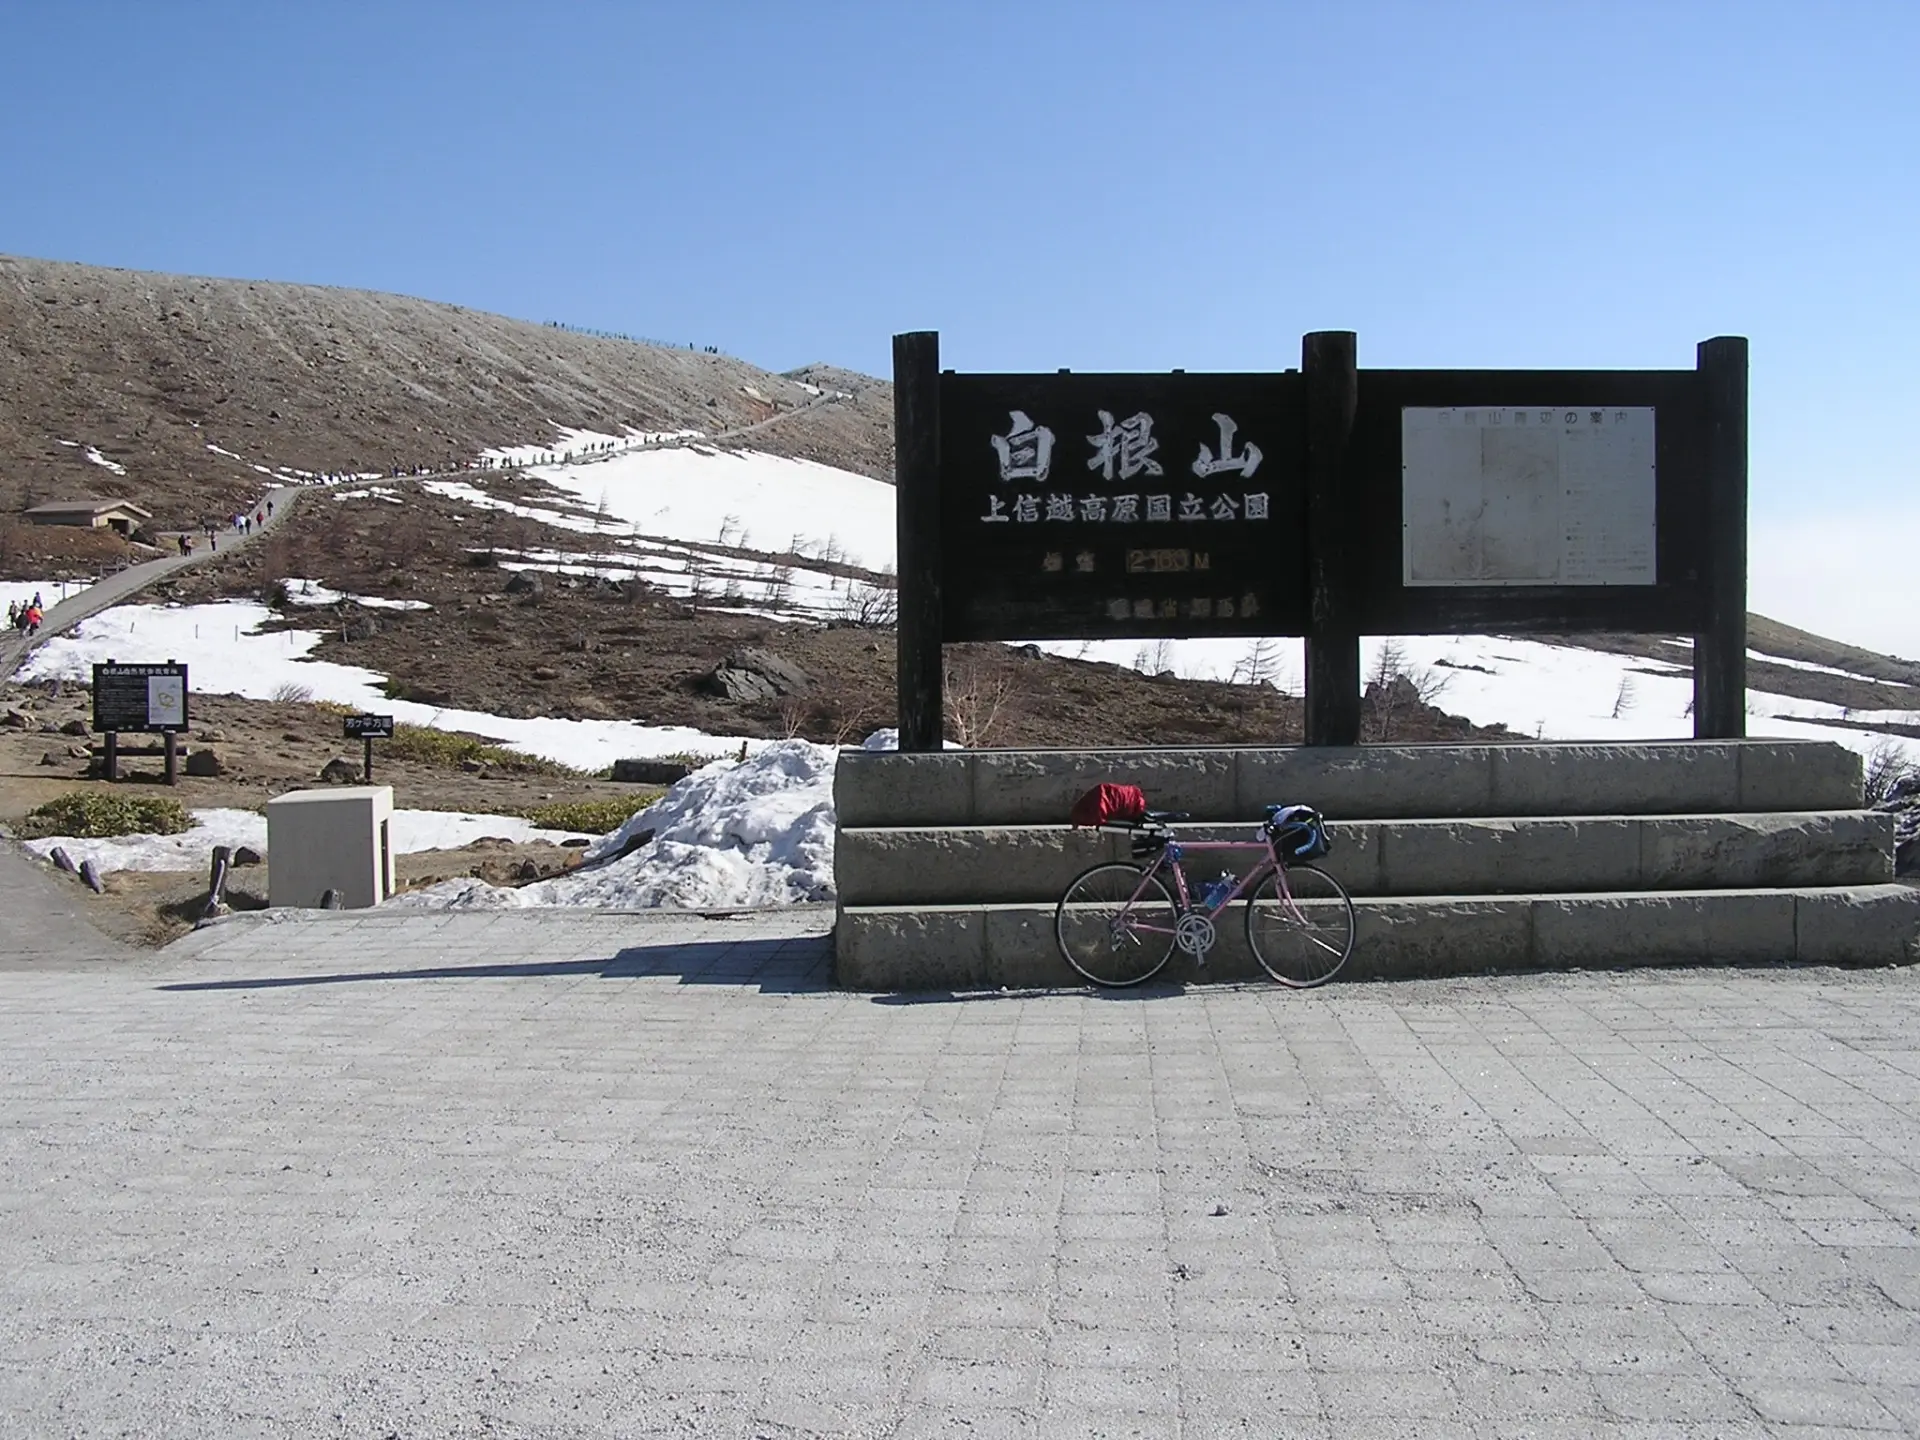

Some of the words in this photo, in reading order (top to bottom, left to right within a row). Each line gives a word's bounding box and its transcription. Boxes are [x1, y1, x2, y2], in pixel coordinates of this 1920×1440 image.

[991, 410, 1263, 481] 白根山
[981, 493, 1269, 522] 上信越高原国立公園
